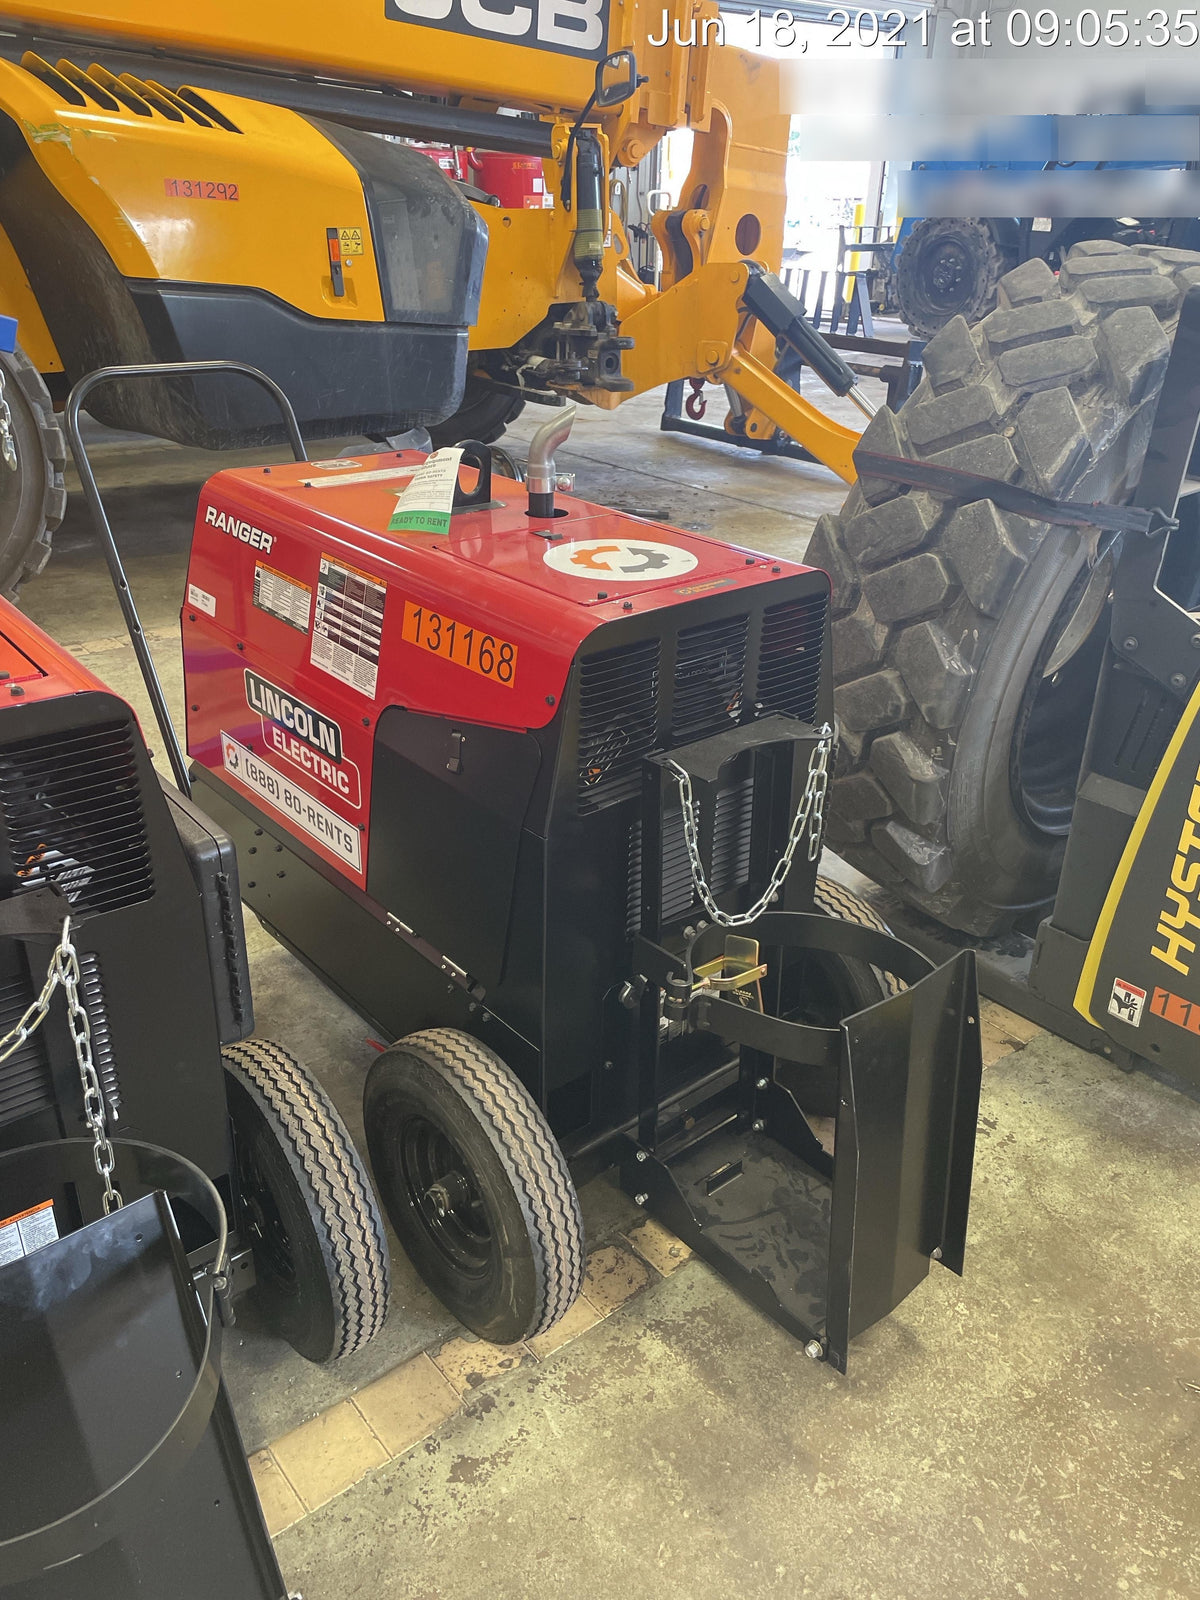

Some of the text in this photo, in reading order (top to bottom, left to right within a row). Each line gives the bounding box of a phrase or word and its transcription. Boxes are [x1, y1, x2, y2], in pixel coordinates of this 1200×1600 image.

[171, 179, 239, 200] 131292
[205, 505, 273, 555] RANGER
[415, 516, 426, 525] TO
[427, 518, 448, 528] RENT
[413, 607, 515, 683] 131168
[249, 676, 337, 758] LINCOLN
[272, 726, 350, 795] ELECTRIC
[245, 757, 353, 854] (888) 80-RENTS
[1150, 764, 1200, 976] HYST
[1157, 993, 1200, 1030] 11
